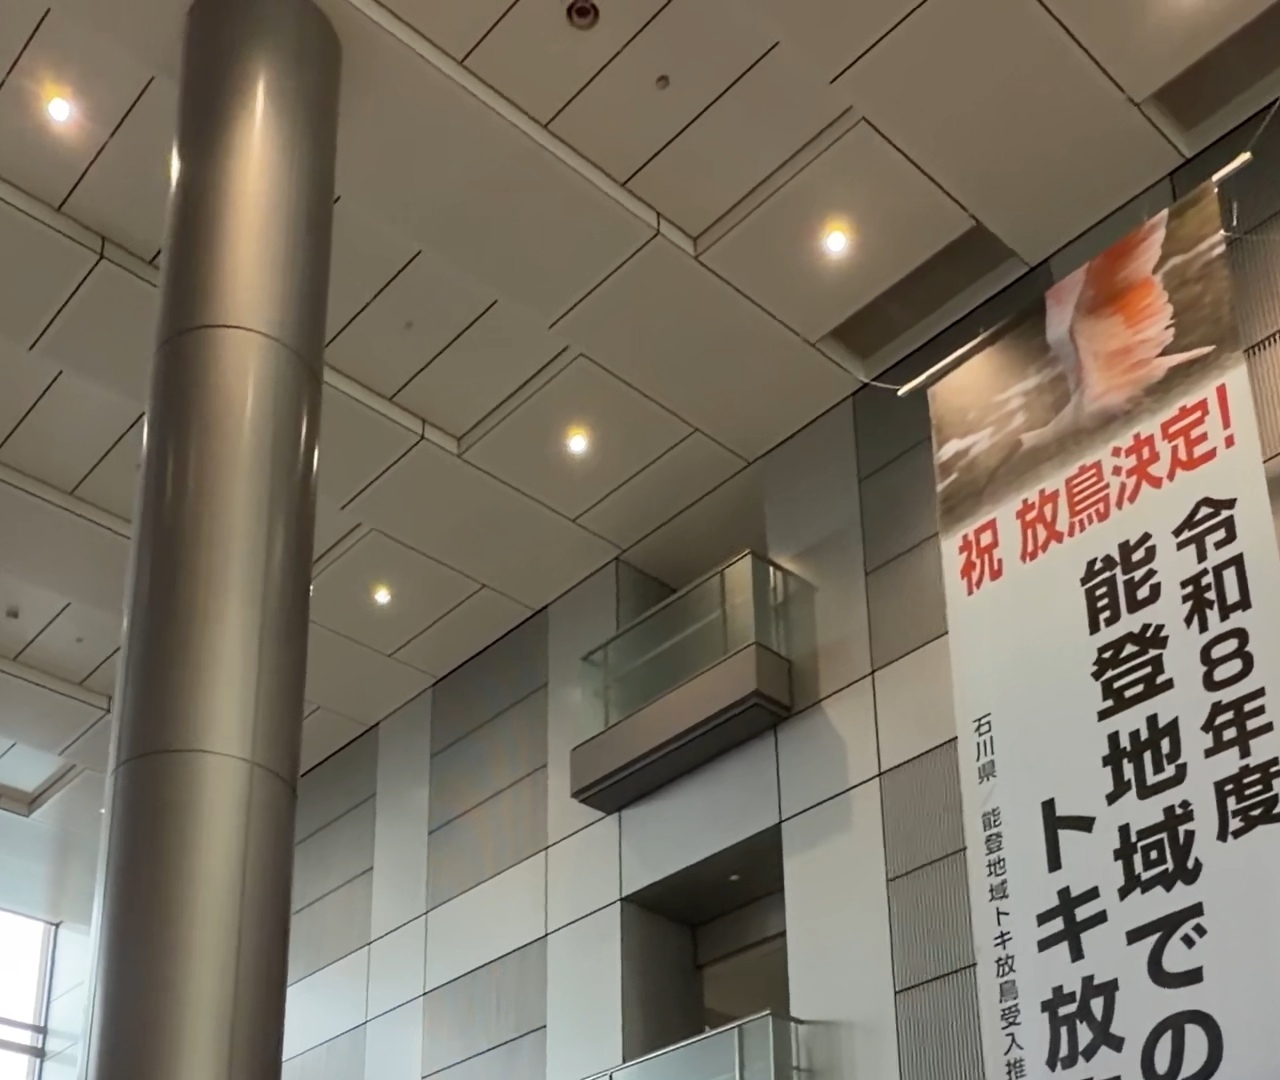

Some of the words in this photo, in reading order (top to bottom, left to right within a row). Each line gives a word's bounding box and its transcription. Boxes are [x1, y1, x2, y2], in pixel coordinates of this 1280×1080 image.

[958, 517, 1003, 597] 祝
[1015, 382, 1237, 565] 放鳥決定!
[972, 712, 998, 786] 石川県
